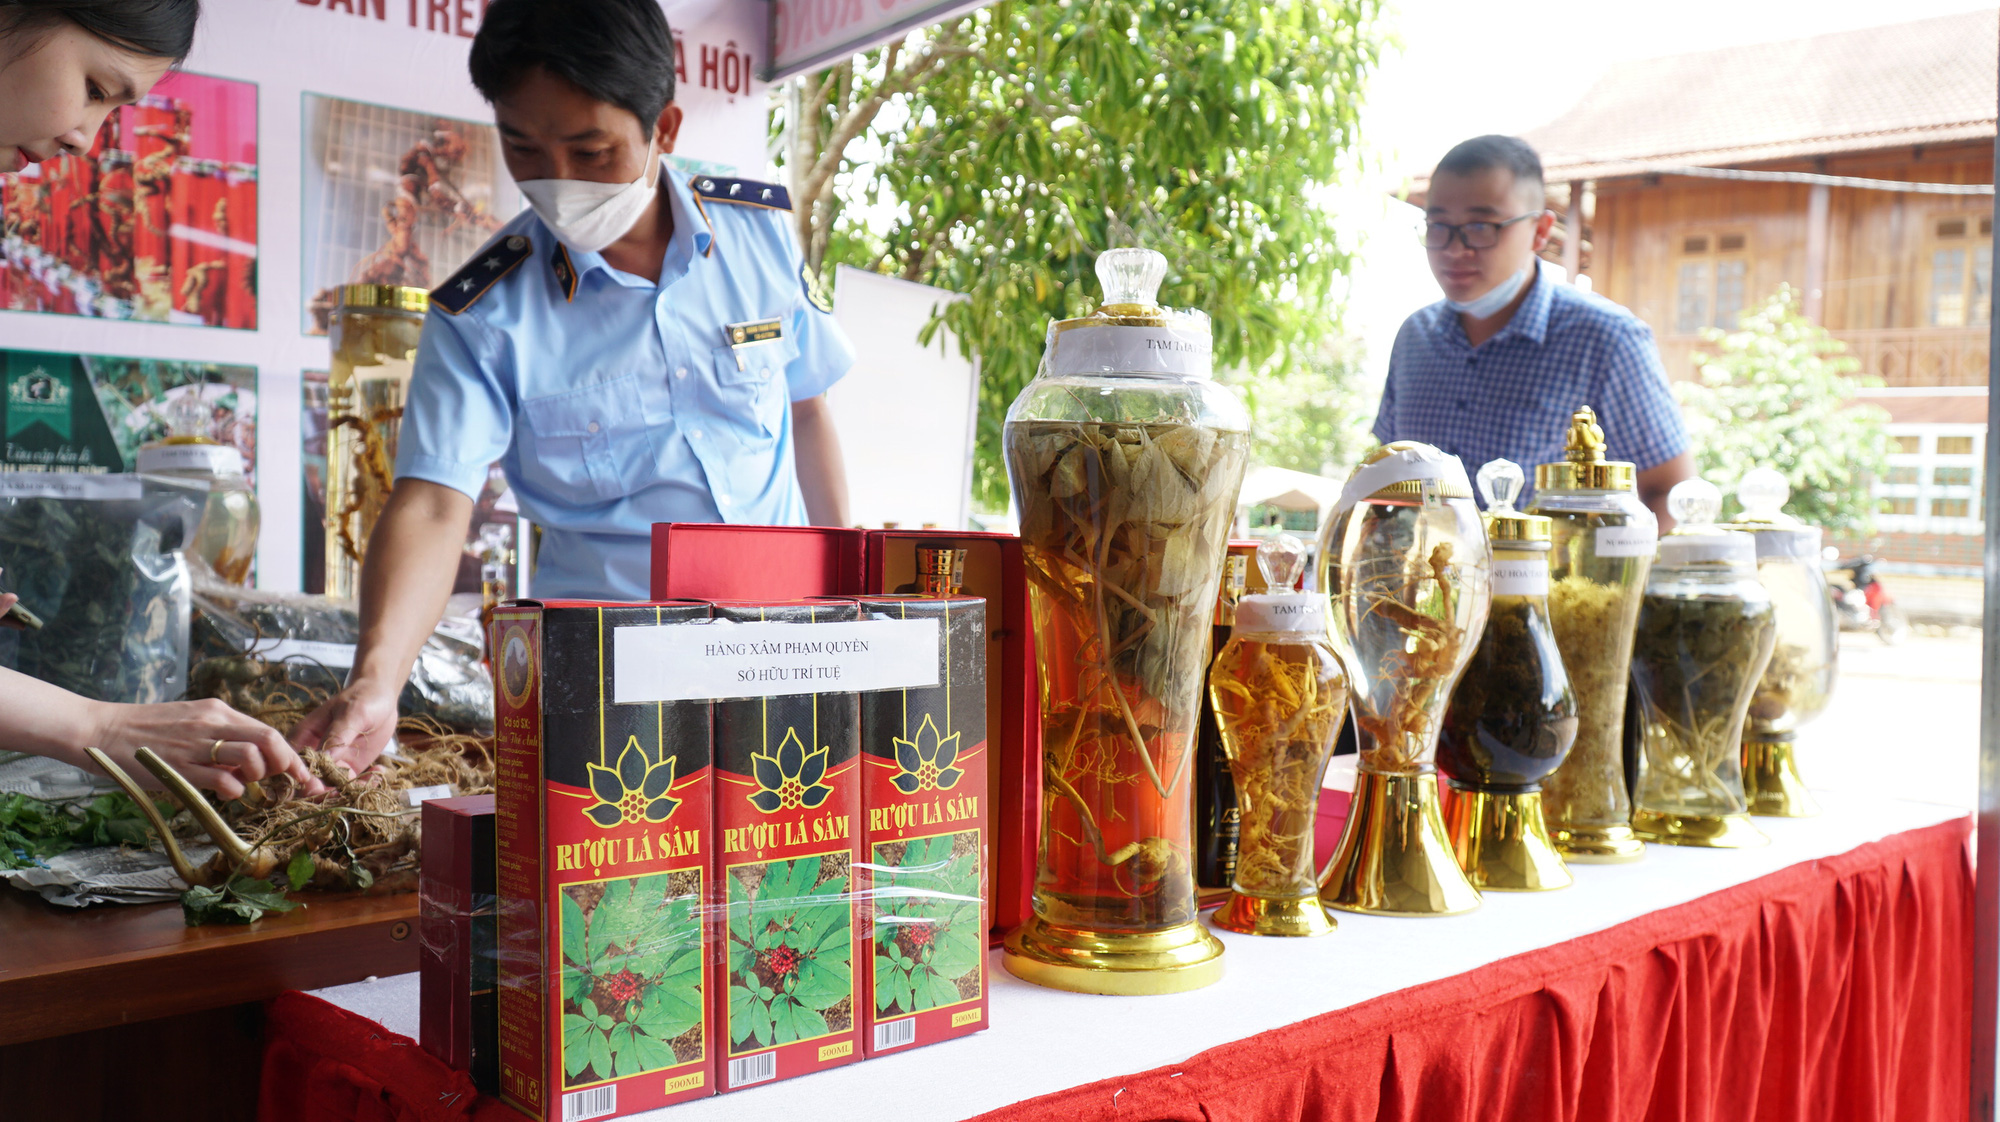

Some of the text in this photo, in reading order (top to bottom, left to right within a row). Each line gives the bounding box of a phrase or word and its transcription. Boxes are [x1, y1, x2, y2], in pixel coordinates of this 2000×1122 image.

[701, 40, 750, 104] HỘI
[1146, 339, 1171, 350] TAM
[1272, 605, 1297, 615] TAM
[705, 641, 746, 656] HÀNG
[750, 640, 781, 655] XÂM
[785, 642, 822, 656] PHẠM
[759, 666, 789, 681] HỮU
[792, 664, 814, 680] TRÍ
[816, 665, 841, 681] TUỆ
[869, 792, 978, 837] RƯỢU LÁ SÂM
[724, 811, 850, 859] RƯỢU LÁ SÂM
[556, 837, 621, 877] RƯỢU
[626, 829, 654, 863] LÁ
[658, 825, 700, 859] SÂM
[955, 1011, 979, 1025] 500ML
[821, 1044, 850, 1059] 500ML
[669, 1076, 702, 1091] 500ML
